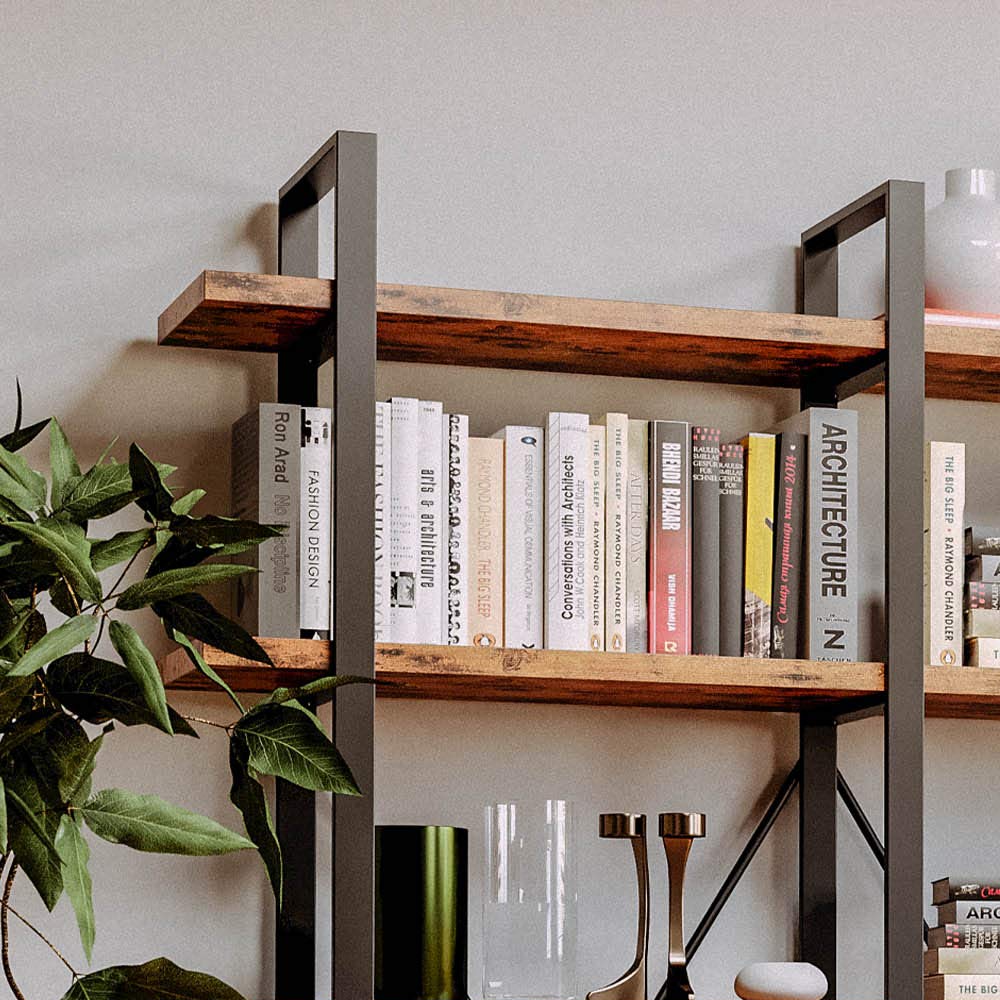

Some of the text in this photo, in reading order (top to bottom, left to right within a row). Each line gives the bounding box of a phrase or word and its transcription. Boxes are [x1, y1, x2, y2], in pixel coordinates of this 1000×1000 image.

[274, 411, 290, 484] Ron Arad
[420, 469, 437, 493] arts
[662, 442, 681, 531] BHENDI BAZAAR
[784, 455, 797, 484] 2014
[308, 470, 319, 589] FASHION DESIGN
[561, 455, 574, 620] Conversations with Architects
[821, 422, 848, 598] ARCHITECTURE
[944, 456, 954, 642] THE BIG SLEEP RAYMOND CHANDLER
[420, 511, 438, 589] architecture
[823, 629, 846, 650] N
[958, 985, 977, 994] THE
[980, 985, 999, 994] BIG
